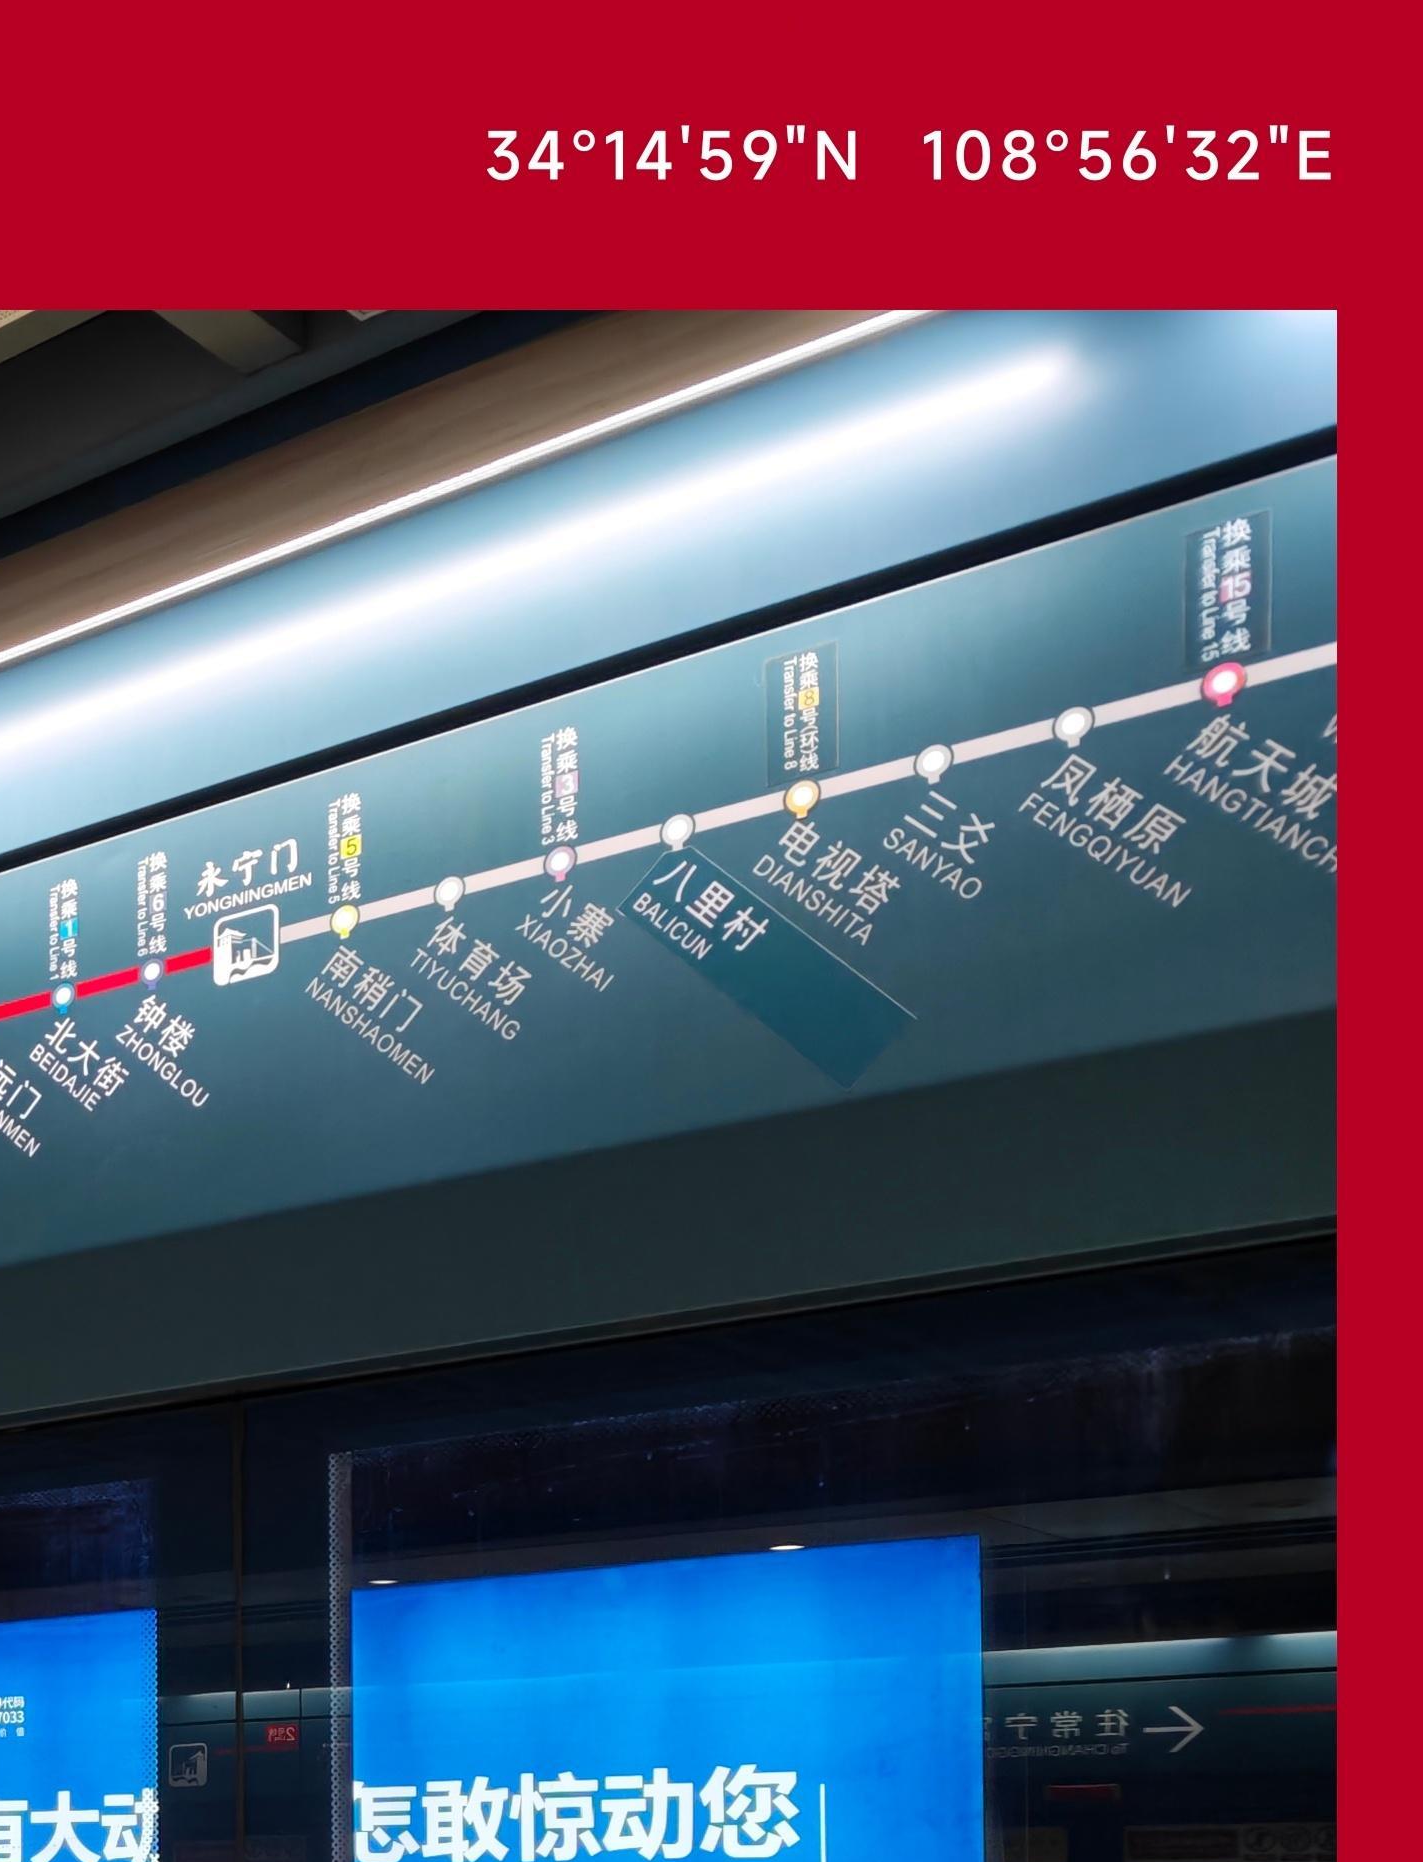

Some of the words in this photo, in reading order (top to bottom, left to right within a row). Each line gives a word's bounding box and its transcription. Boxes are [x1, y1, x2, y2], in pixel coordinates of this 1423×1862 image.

[1201, 607, 1220, 640] Line
[1220, 518, 1252, 656] 换乘15号线
[784, 656, 797, 710] Transfer
[541, 733, 555, 788] Transfer
[784, 729, 797, 758] Line
[1187, 713, 1337, 820] 航天城
[328, 798, 340, 851] Transfer
[541, 805, 555, 836] Line
[555, 726, 579, 843] 换乘3号线
[1039, 753, 1186, 855] 凤栖原
[196, 838, 299, 898] 永宁门
[341, 792, 362, 902] 换乘5号线
[882, 828, 983, 900] SANYAO
[903, 791, 996, 865] 三爻
[1017, 793, 1192, 908] FENGQIYUAN
[149, 850, 168, 955] 换乘6号线
[183, 872, 313, 920] YONGNINGMEN
[328, 866, 340, 893] Line
[652, 860, 770, 953] 八里村
[752, 854, 874, 946] DIANSHITA
[777, 821, 901, 916] 电视塔
[60, 878, 78, 980] 换乘1号线
[138, 921, 148, 947] Line
[515, 913, 615, 993] XIAOZHAI
[540, 884, 615, 948] 小寨
[632, 892, 714, 961] BALICUN
[50, 946, 60, 972] Line
[319, 944, 424, 1035] 南稍门
[408, 947, 522, 1042] TIYUCHANG
[426, 915, 533, 1007] 体育场
[44, 1016, 130, 1099] 北大街
[115, 1024, 210, 1109] ZHONGLOU
[132, 994, 196, 1060] 钟楼
[304, 977, 435, 1086] NANSHAOMEN
[28, 1044, 102, 1113] BEIDAJIE
